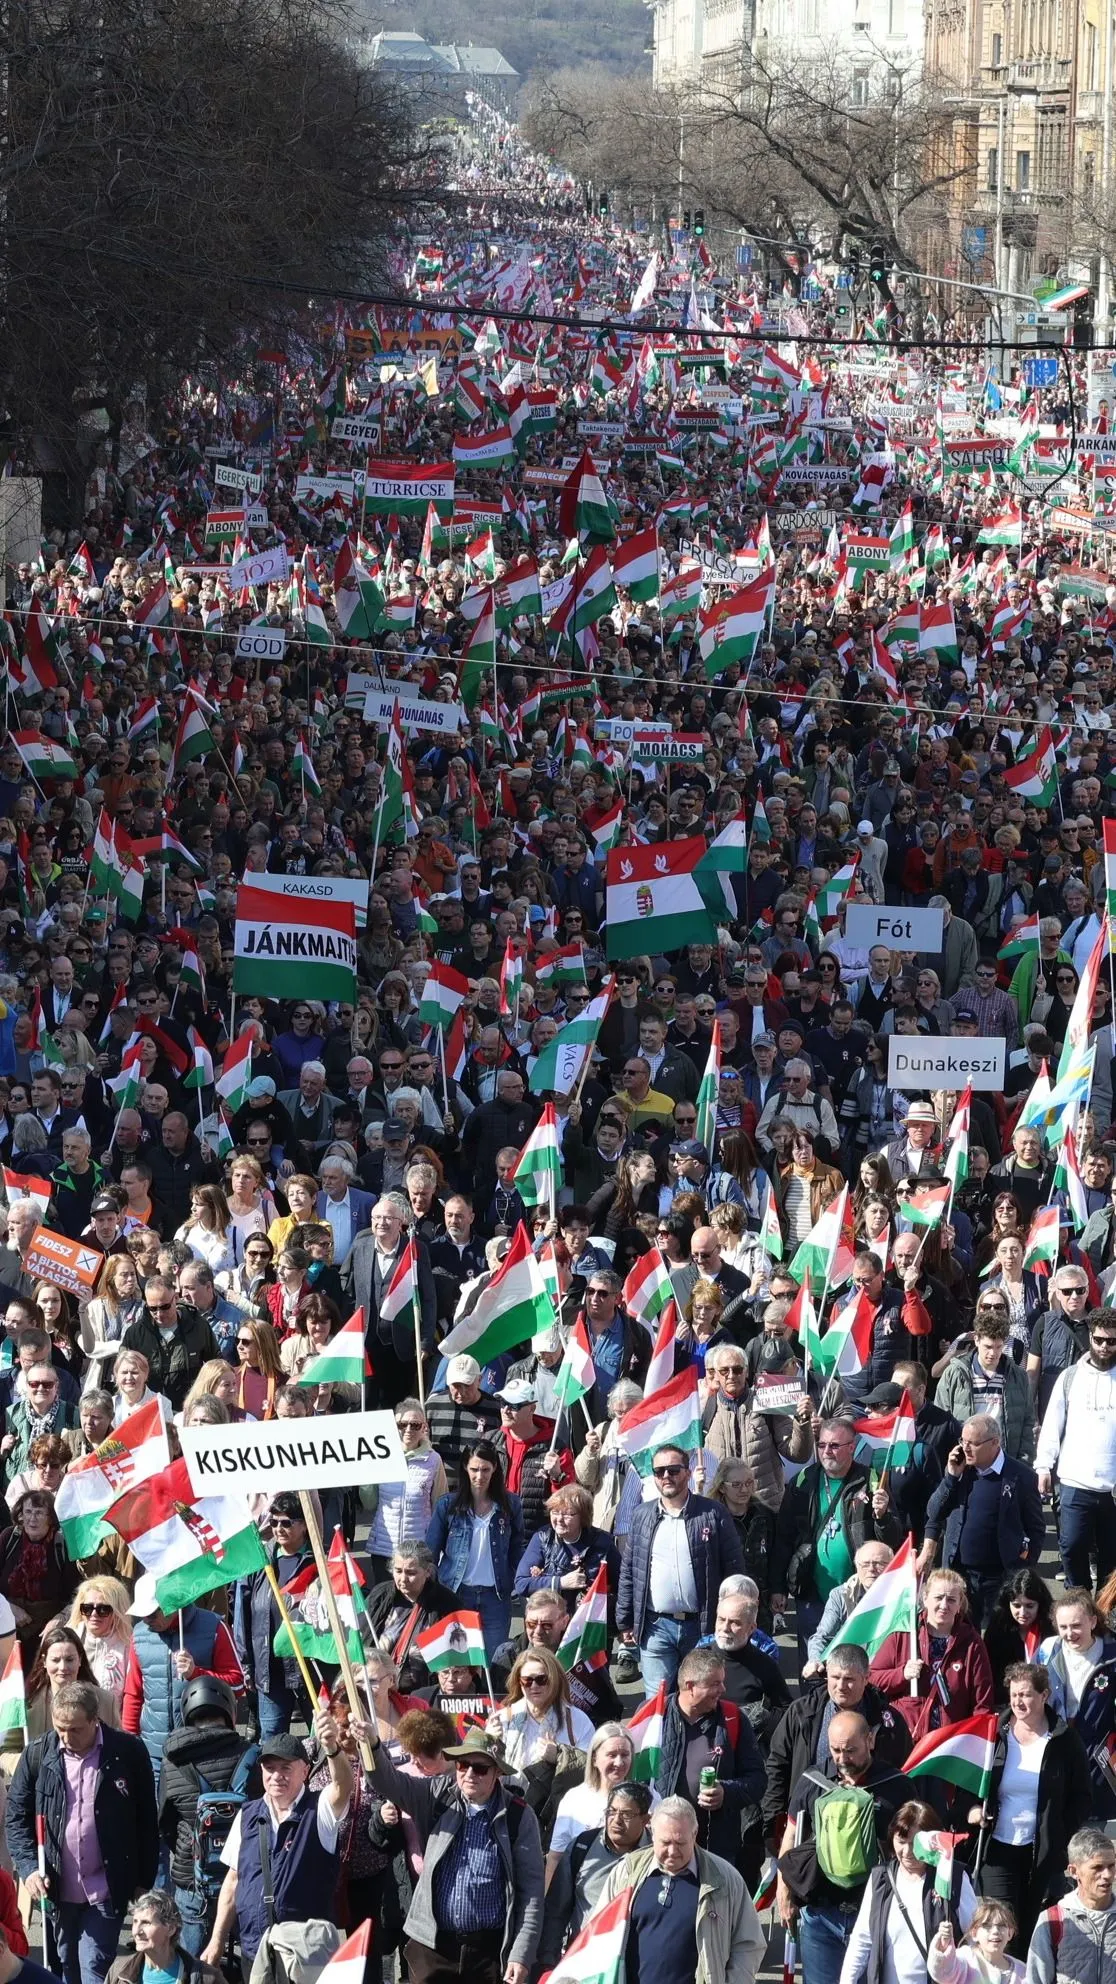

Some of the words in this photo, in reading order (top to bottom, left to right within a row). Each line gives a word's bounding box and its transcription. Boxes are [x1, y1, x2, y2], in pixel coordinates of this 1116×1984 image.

[344, 424, 378, 440] EGYED
[785, 468, 847, 480] KOVÁCSVAGÁS
[372, 480, 446, 497] TÚRRICSE
[208, 522, 243, 533] ABONY
[848, 547, 889, 560] ABONY
[239, 634, 282, 655] GÖD
[379, 703, 444, 726] HADÚNÁNÁS
[639, 742, 698, 758] MOHÁCS
[283, 883, 333, 896] KAKASD
[876, 918, 912, 939] Fót
[896, 1054, 998, 1073] Dunakeszi
[35, 1235, 73, 1258] FIDESZ
[28, 1251, 38, 1262] A
[39, 1255, 78, 1279] BIZTOS
[195, 1434, 392, 1475] KISKUNHALAS
